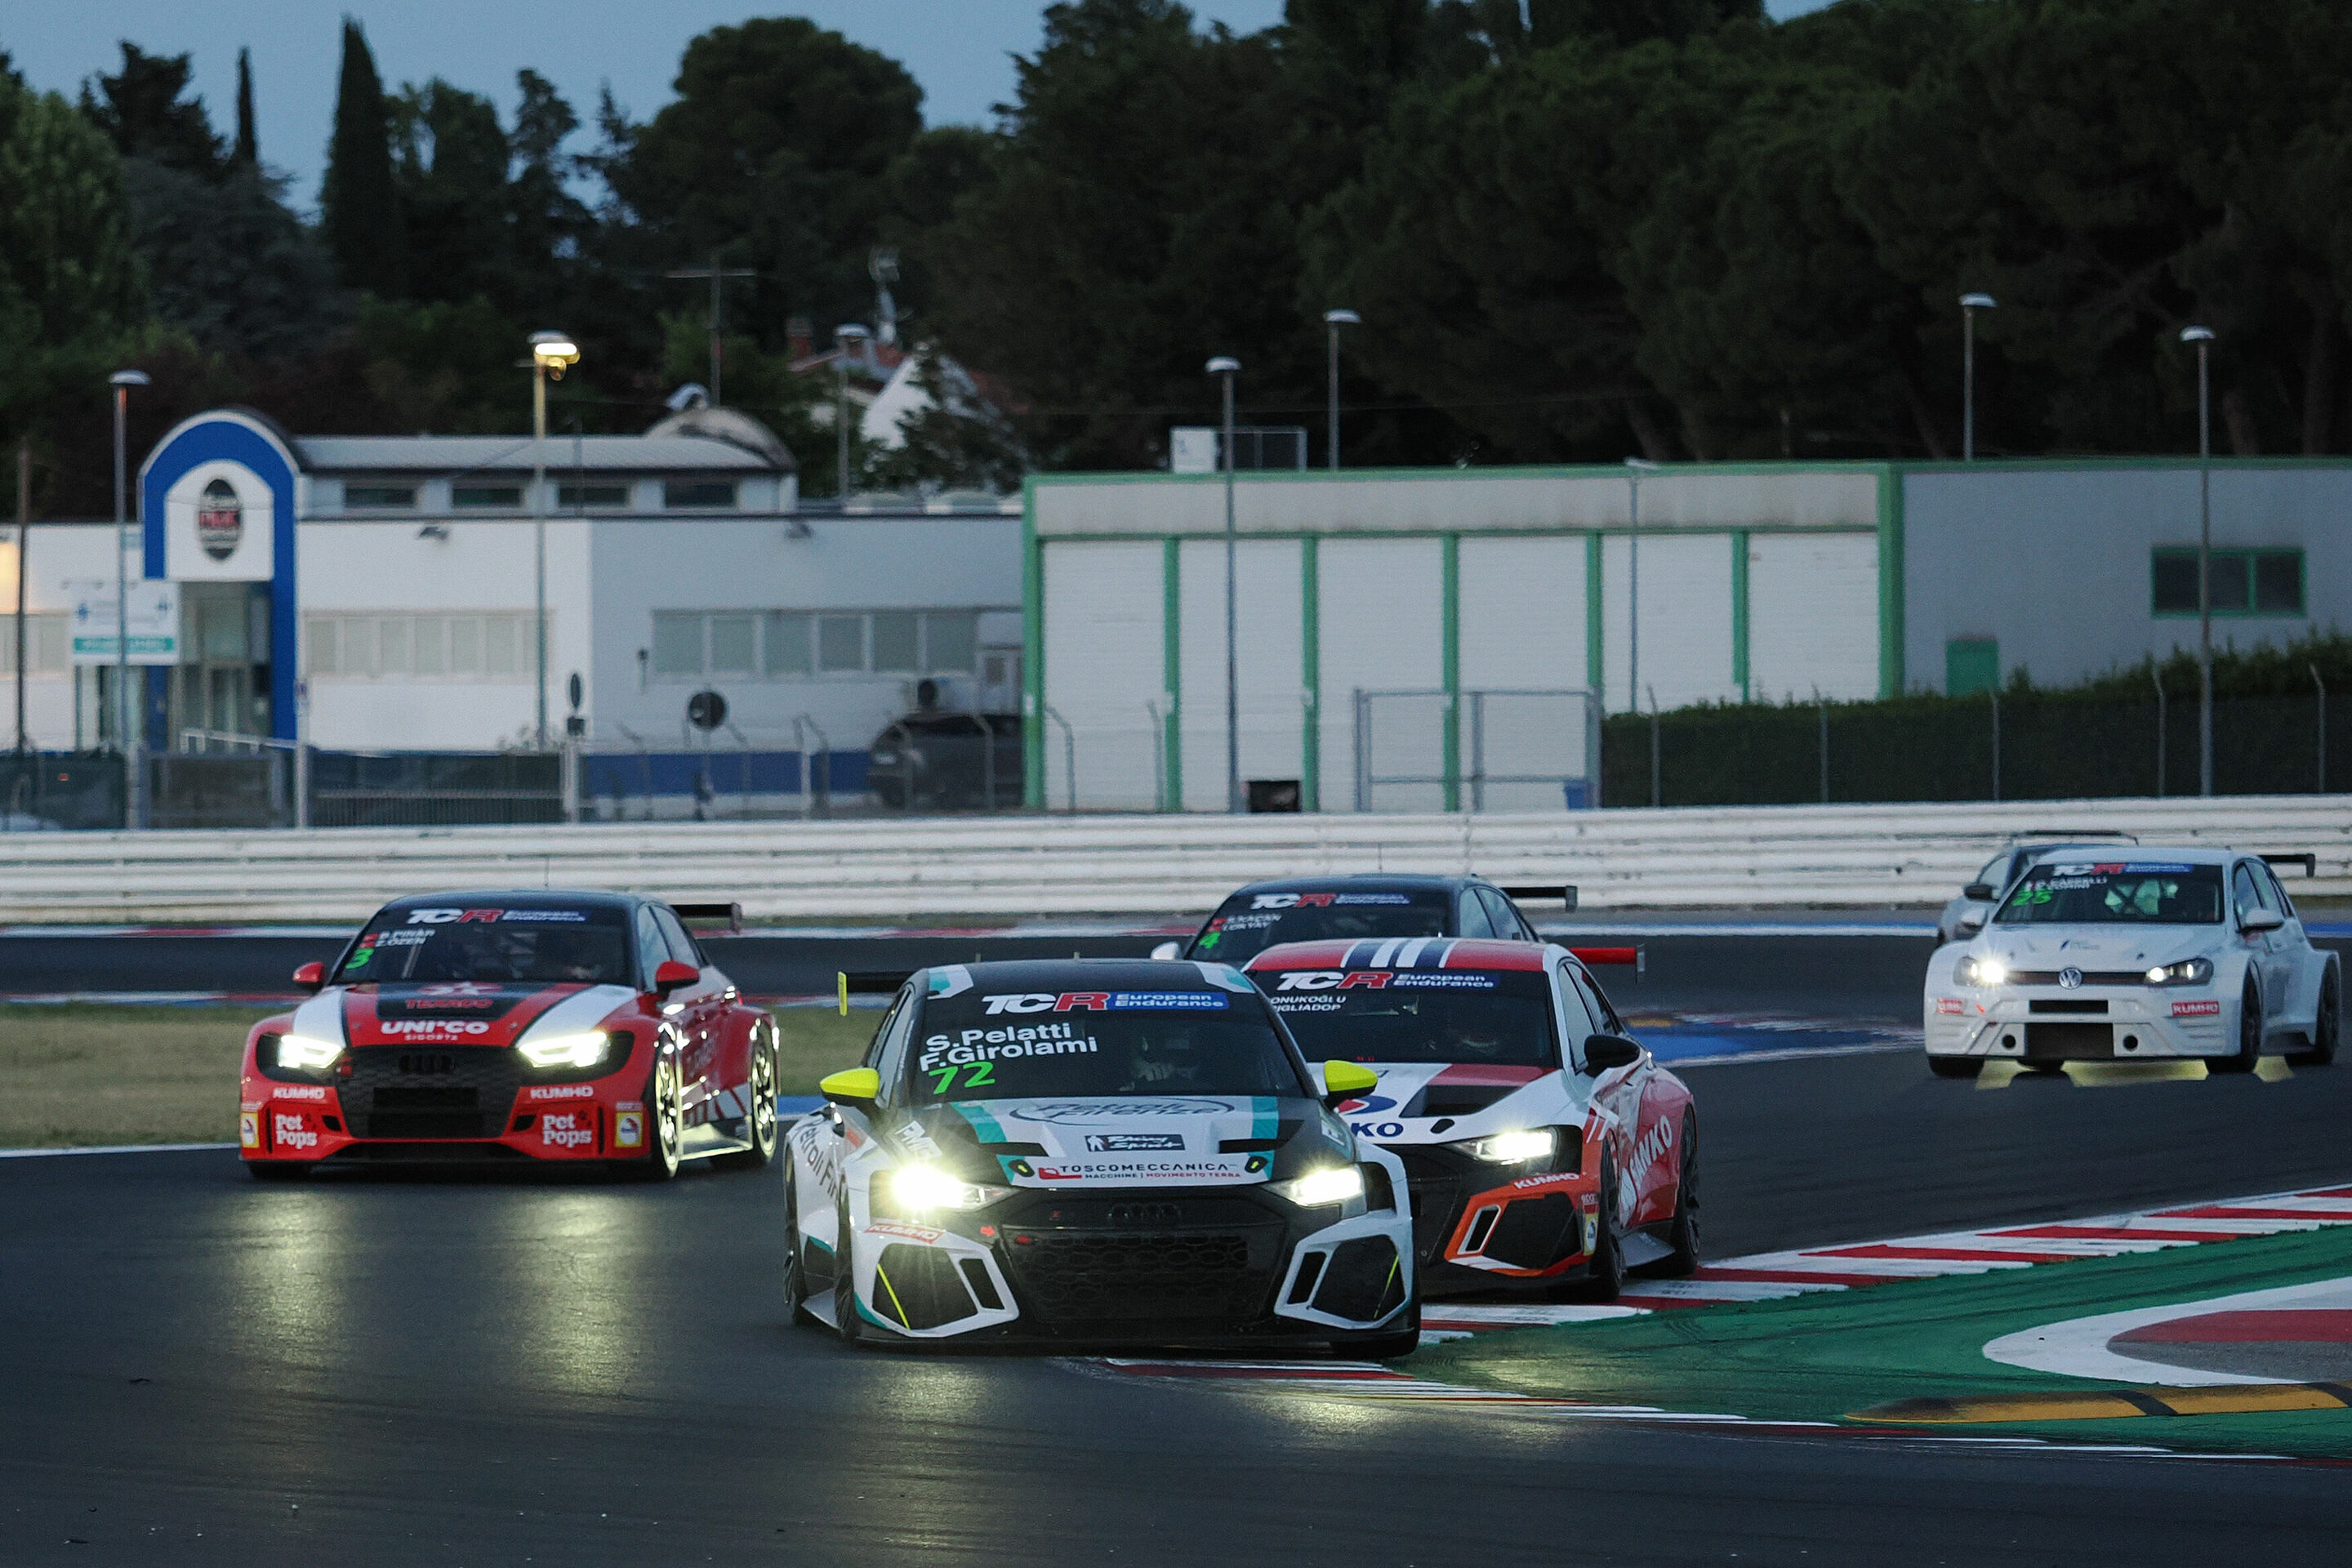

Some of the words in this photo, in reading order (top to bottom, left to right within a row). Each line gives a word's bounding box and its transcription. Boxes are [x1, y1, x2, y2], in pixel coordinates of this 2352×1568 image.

[408, 907, 505, 924] TCR
[345, 947, 374, 969] 3
[1276, 971, 1393, 991] TCR
[1396, 973, 1486, 982] European
[982, 991, 1111, 1015] TCR
[1116, 994, 1213, 1002] European
[2172, 1003, 2219, 1013] KUMHO
[925, 1022, 1072, 1054] S.Pelatti
[919, 1036, 1098, 1072] F.Girolami
[928, 1061, 996, 1095] 72
[530, 1085, 594, 1098] KUMHO
[275, 1113, 303, 1130] Pet
[542, 1113, 575, 1129] Pet
[276, 1129, 318, 1150] Pops
[542, 1129, 592, 1148] Pops
[1060, 1162, 1229, 1173] TOSCOMECCANICA
[1513, 1172, 1580, 1190] KUMHO
